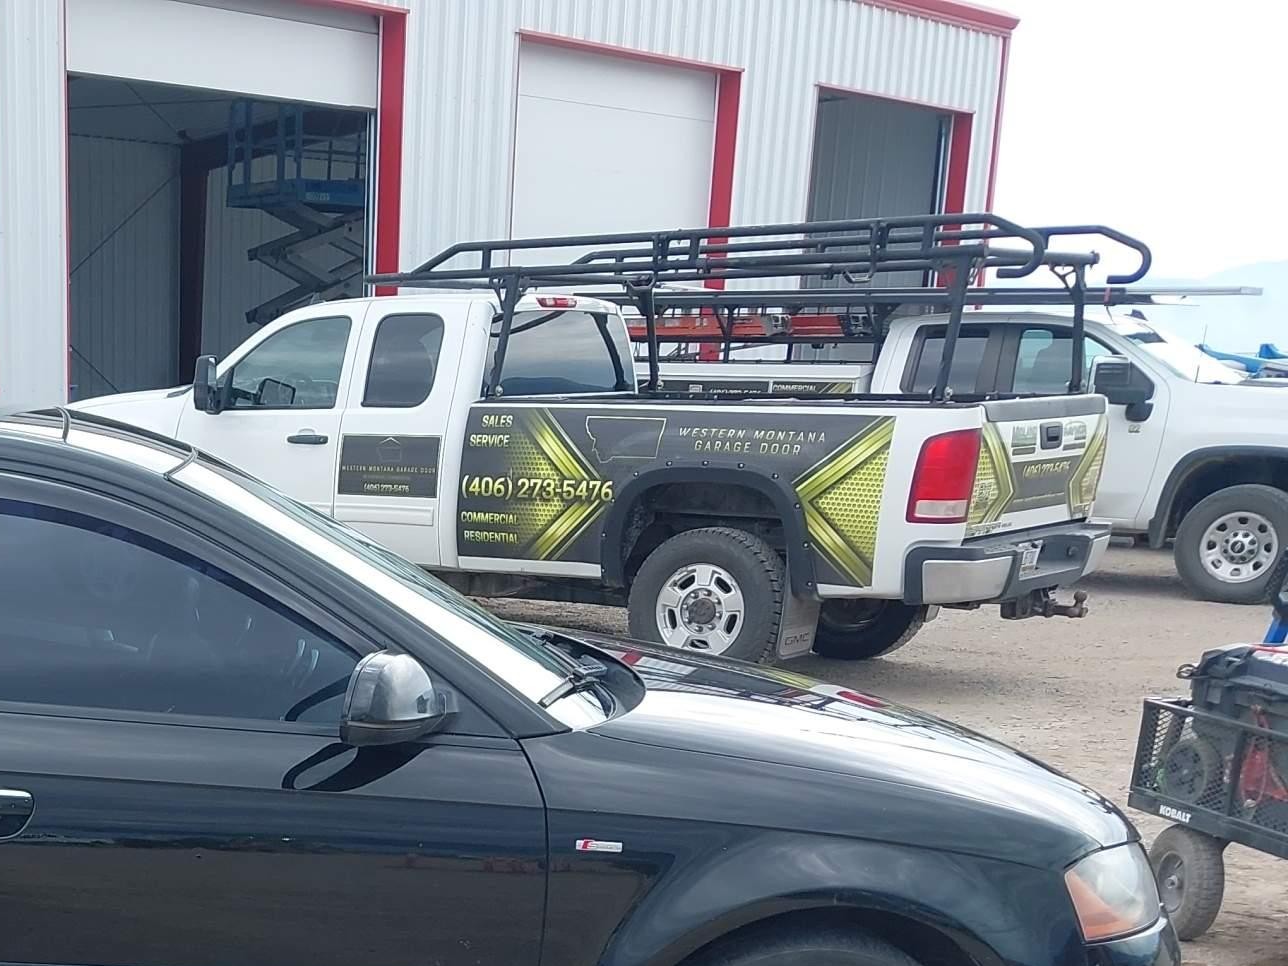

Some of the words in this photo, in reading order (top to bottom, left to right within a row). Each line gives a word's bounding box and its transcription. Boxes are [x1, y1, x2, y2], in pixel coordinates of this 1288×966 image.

[481, 414, 513, 428] SALES
[469, 434, 510, 447] SERVICE
[679, 427, 746, 439] WESTERN
[753, 430, 826, 443] MONTANA
[694, 440, 752, 453] GARAGE
[759, 442, 802, 456] DOOR
[461, 474, 513, 501] (406)
[517, 477, 614, 501] 273-5476
[461, 511, 518, 525] COMMERCIAL
[463, 530, 519, 544] RESIDENTIAL
[1159, 804, 1192, 824] KOBALT
